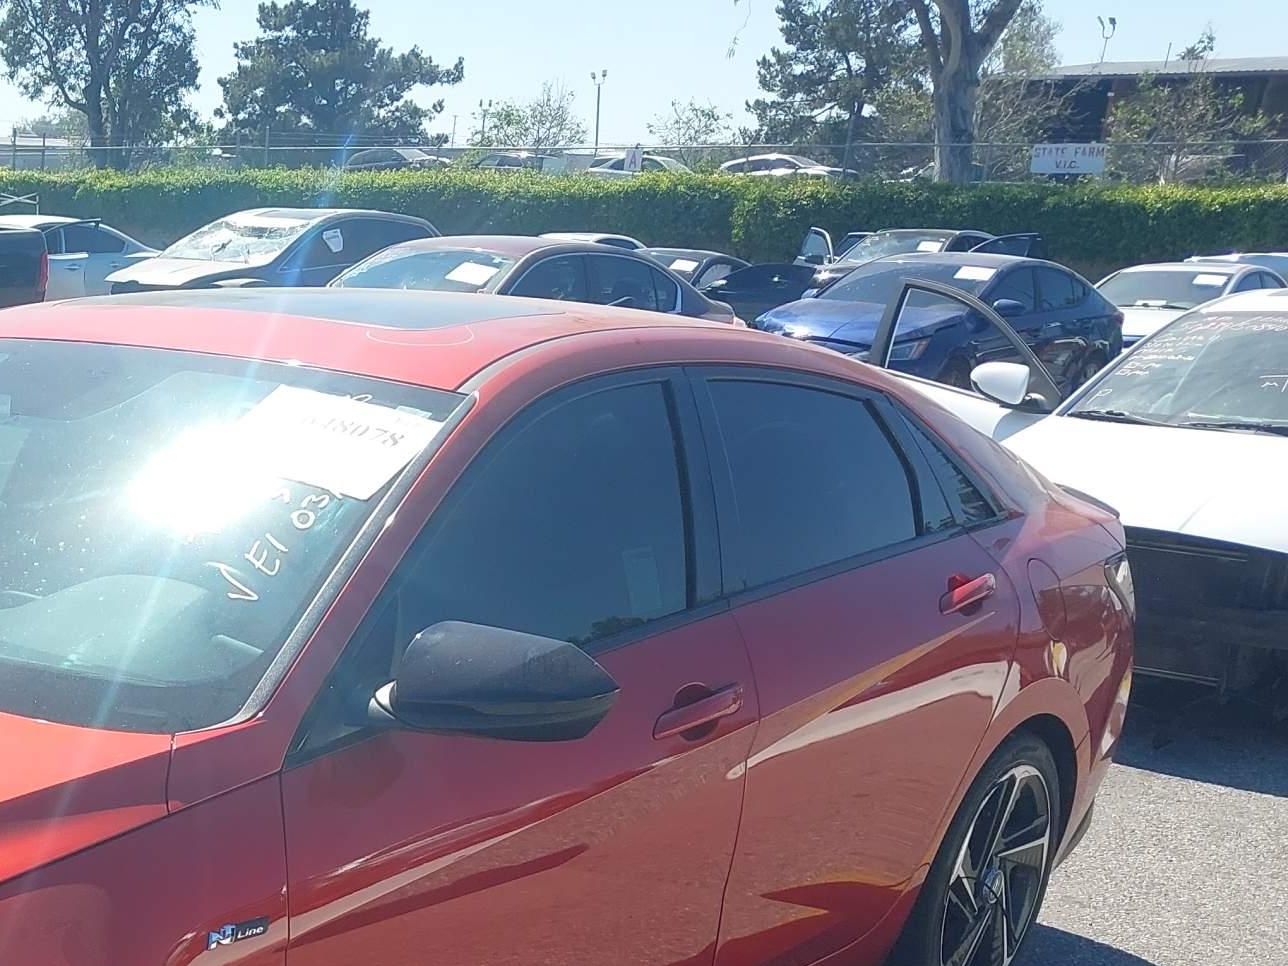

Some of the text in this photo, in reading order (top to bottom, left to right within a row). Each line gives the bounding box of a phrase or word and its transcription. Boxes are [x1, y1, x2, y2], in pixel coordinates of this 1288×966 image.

[628, 151, 637, 168] A
[1034, 147, 1106, 158] STATE FARM
[207, 924, 264, 950] N Line
